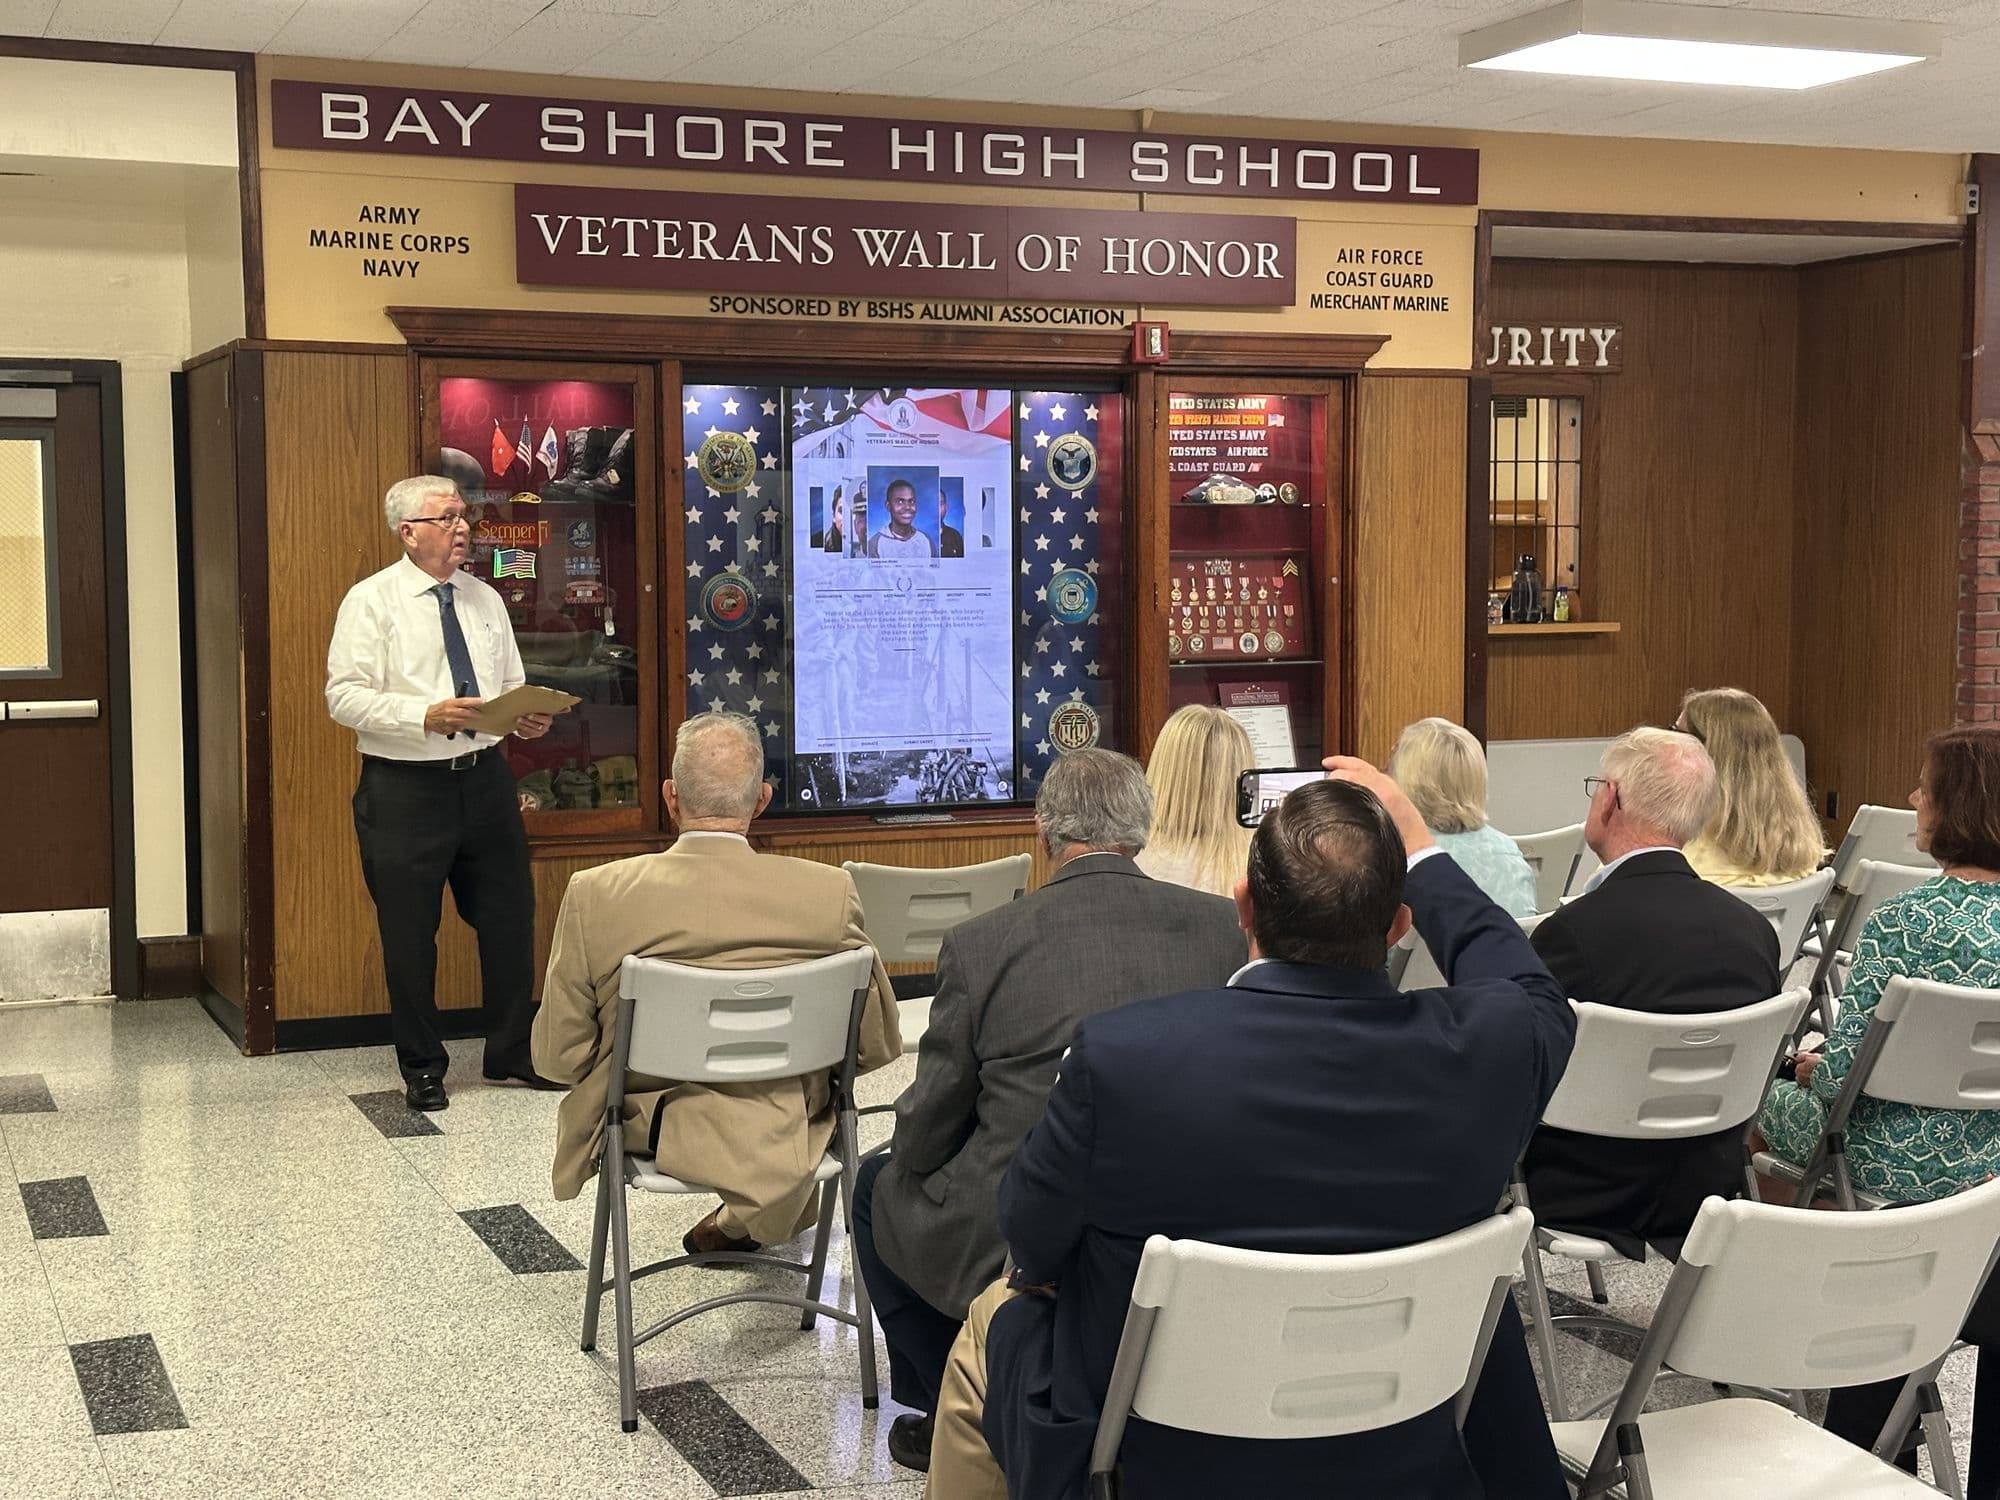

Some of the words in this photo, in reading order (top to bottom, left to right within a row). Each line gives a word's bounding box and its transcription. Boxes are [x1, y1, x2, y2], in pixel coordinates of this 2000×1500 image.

[321, 92, 491, 147] BAY
[540, 107, 845, 168] SHORE
[890, 127, 1086, 179] HIGH
[1131, 141, 1441, 195] SCHOOL
[358, 205, 421, 226] ARMY
[309, 228, 395, 252] MARINE
[400, 234, 471, 255] CORPS
[531, 213, 834, 266] VETERANS
[852, 227, 997, 272] WALL
[1016, 233, 1082, 273] OF
[1102, 237, 1285, 280] HONOR
[1336, 247, 1365, 265] AIR
[1371, 248, 1424, 266] FORCE
[362, 258, 420, 279] NAVY
[1326, 270, 1376, 289] COAST
[1380, 272, 1434, 290] GUARD
[709, 295, 832, 318] SPONSORED
[838, 299, 862, 318] BY
[867, 300, 914, 321] BSHS
[919, 303, 994, 323] ALUMNI
[999, 305, 1125, 327] ASSOCIATION
[1310, 293, 1390, 311] MERCHANT
[1393, 295, 1449, 312] MARINE
[1196, 398, 1235, 410] STATES
[1237, 398, 1268, 410] ARMY
[1196, 430, 1237, 441] STATES
[1239, 430, 1267, 441] NAVY
[1184, 447, 1217, 457] STATES
[1227, 447, 1241, 457] AIR
[1242, 447, 1269, 457] FORCE
[1178, 463, 1209, 472] COAST
[1212, 463, 1246, 472] GUARD
[478, 520, 533, 547] Semper
[538, 520, 549, 548] Fi
